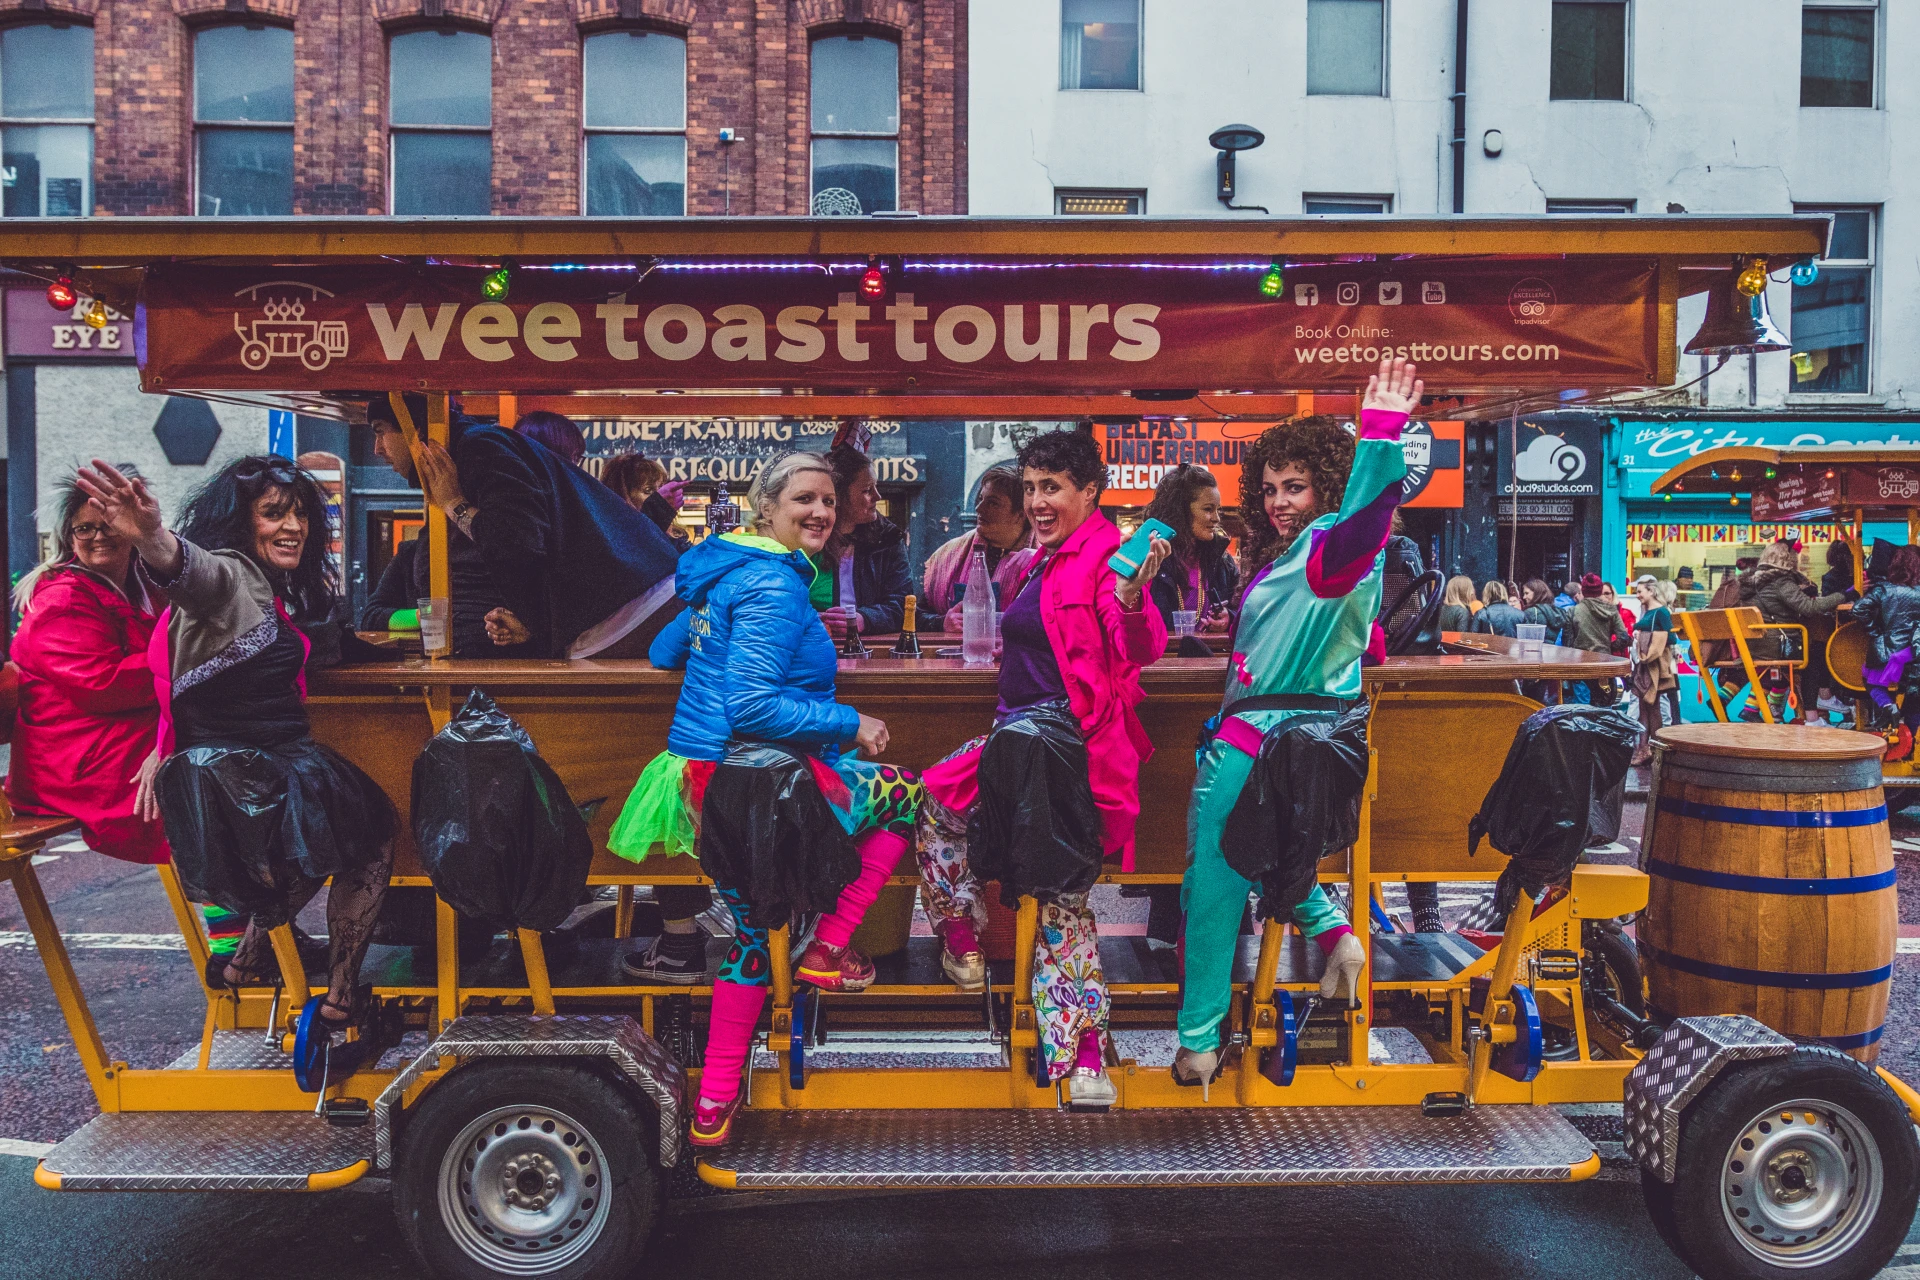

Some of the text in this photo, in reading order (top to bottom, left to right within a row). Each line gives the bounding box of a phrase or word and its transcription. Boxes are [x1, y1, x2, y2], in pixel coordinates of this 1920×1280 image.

[366, 291, 1161, 362] wee toast tours
[1514, 318, 1551, 326] tripadvisor
[52, 325, 121, 349] EYE
[1295, 325, 1394, 339] Book Online:
[1295, 342, 1560, 363] weetoasttours.com
[582, 421, 661, 441] TURE
[1635, 427, 1674, 441] the
[1403, 441, 1427, 449] ading
[1106, 440, 1254, 465] UNDERGROUN
[1402, 450, 1418, 459] nly
[1622, 455, 1635, 465] 31
[1504, 483, 1594, 493] cloud9studios.com
[1516, 505, 1528, 513] 28
[1066, 922, 1093, 942] PEACE
